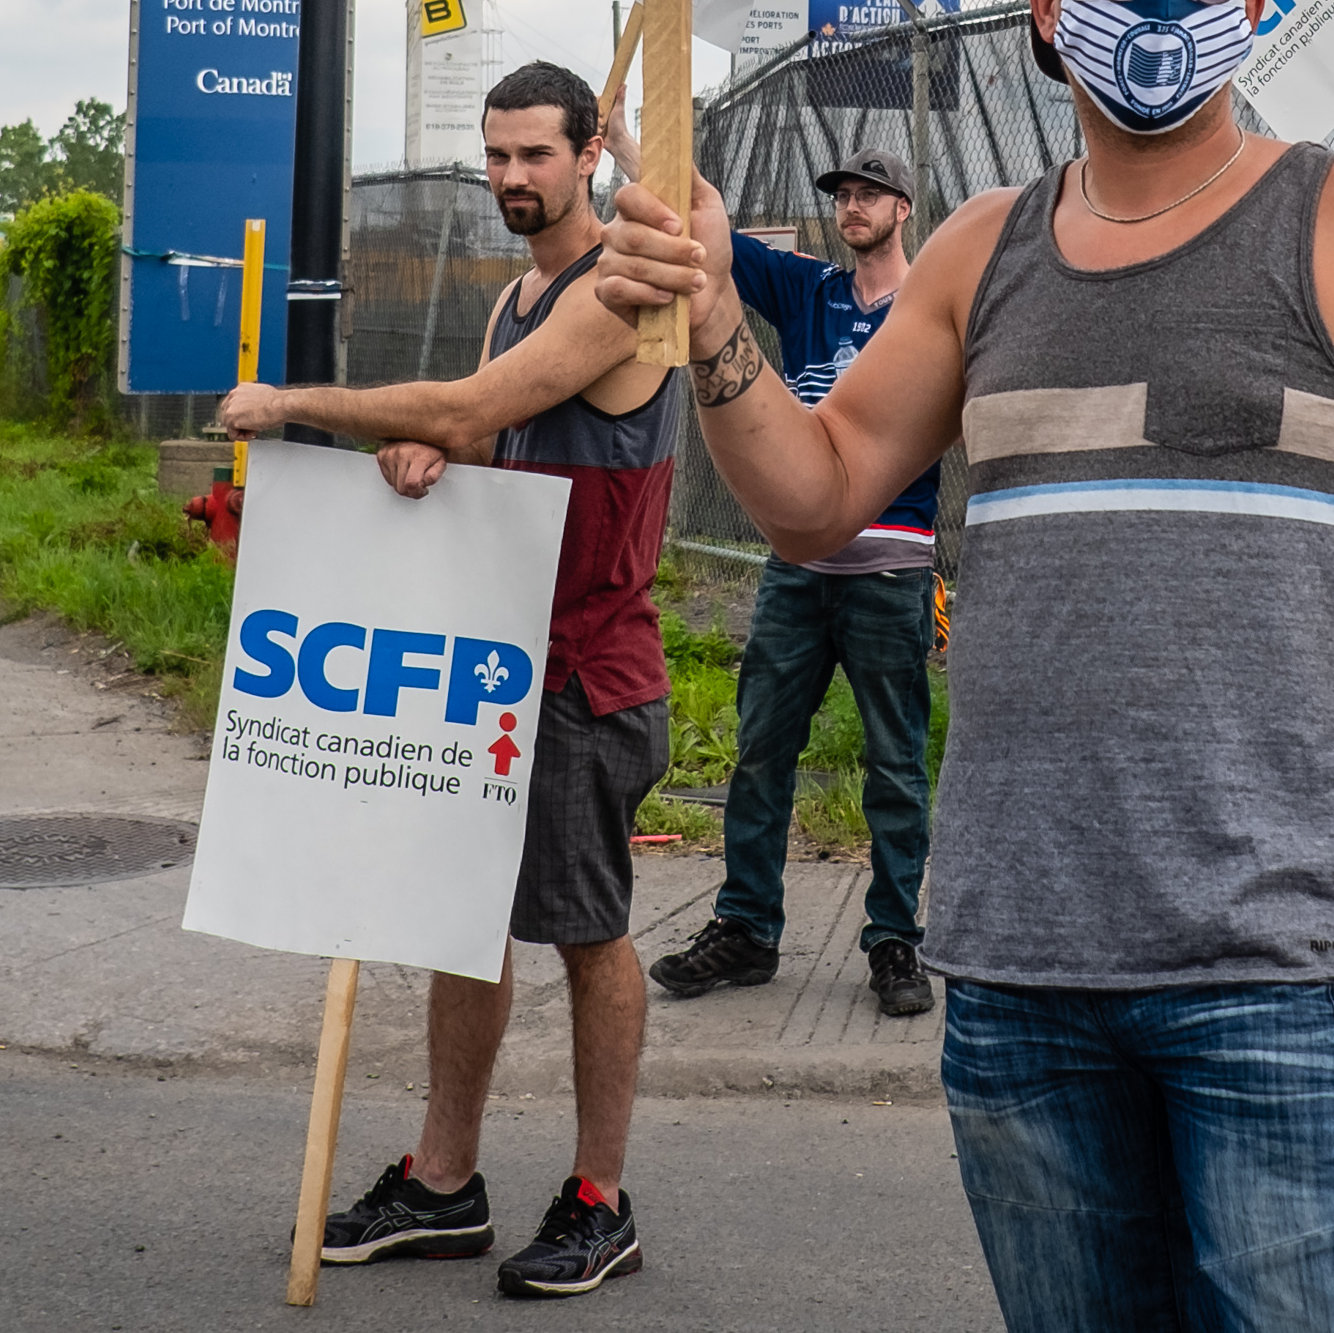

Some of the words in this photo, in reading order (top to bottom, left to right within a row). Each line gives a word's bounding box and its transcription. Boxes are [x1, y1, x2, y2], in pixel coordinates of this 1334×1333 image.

[167, 16, 206, 34] Port
[213, 16, 234, 35] of
[238, 18, 299, 38] Montr
[750, 8, 799, 20] ÉLIORATION
[758, 21, 783, 30] PORTS
[1238, 43, 1281, 88] Syndicat
[1279, 0, 1323, 46] canadien
[197, 69, 292, 96] Canada
[1246, 84, 1260, 98] la
[1257, 43, 1300, 87] fonction
[873, 295, 892, 307] TOUS
[233, 608, 533, 726] SCFP
[226, 709, 310, 748] Syndicat
[317, 732, 432, 762] canadien
[441, 741, 473, 767] de
[223, 736, 240, 761] la
[246, 741, 336, 781] fonction
[344, 763, 460, 796] publique
[483, 782, 517, 805] FTQ
